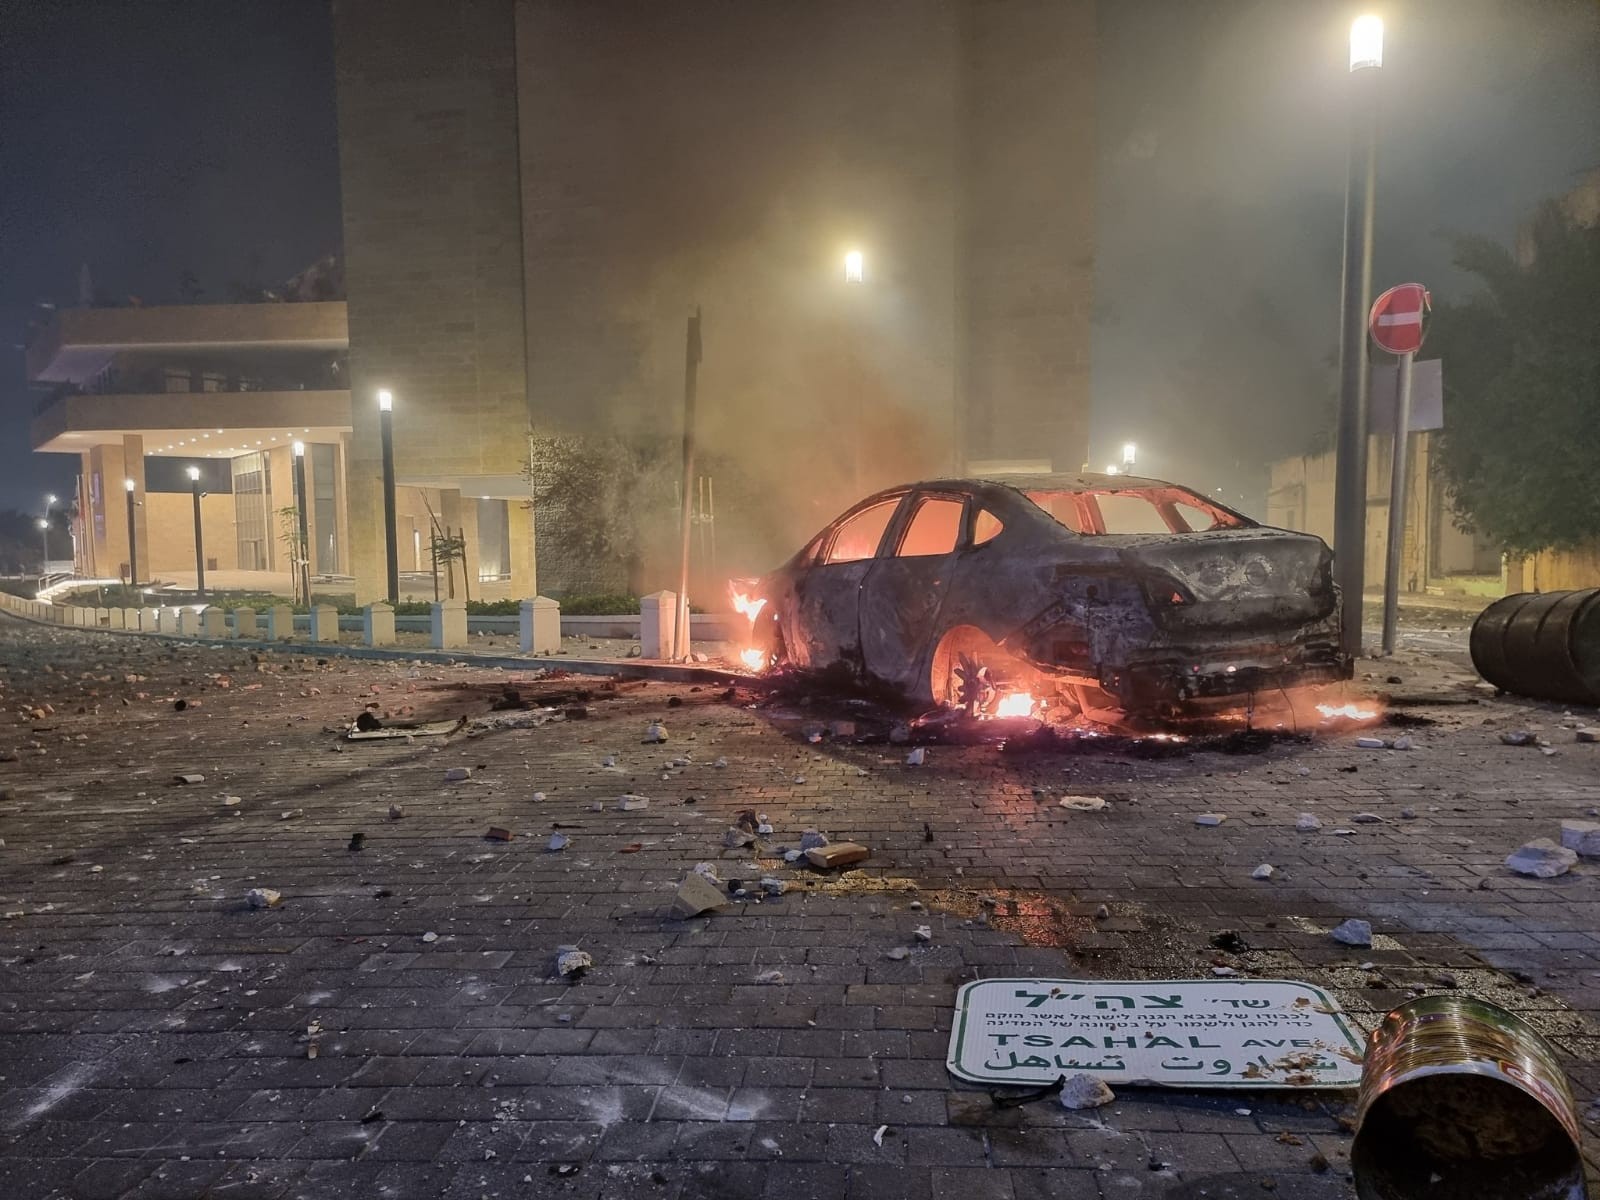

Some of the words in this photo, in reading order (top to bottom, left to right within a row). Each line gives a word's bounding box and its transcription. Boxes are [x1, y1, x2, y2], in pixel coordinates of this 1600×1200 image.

[985, 1012, 1024, 1020] הוקם
[1183, 1012, 1217, 1020] צבא
[1223, 1012, 1249, 1020] של
[986, 1020, 1044, 1028] המדינה
[1049, 1020, 1073, 1028] של
[1145, 1020, 1167, 1029] על
[1173, 1020, 1235, 1028] ולשמור
[1242, 1020, 1278, 1029] להגן
[987, 1033, 1221, 1049] TSAHAL
[1241, 1039, 1312, 1048] AVE
